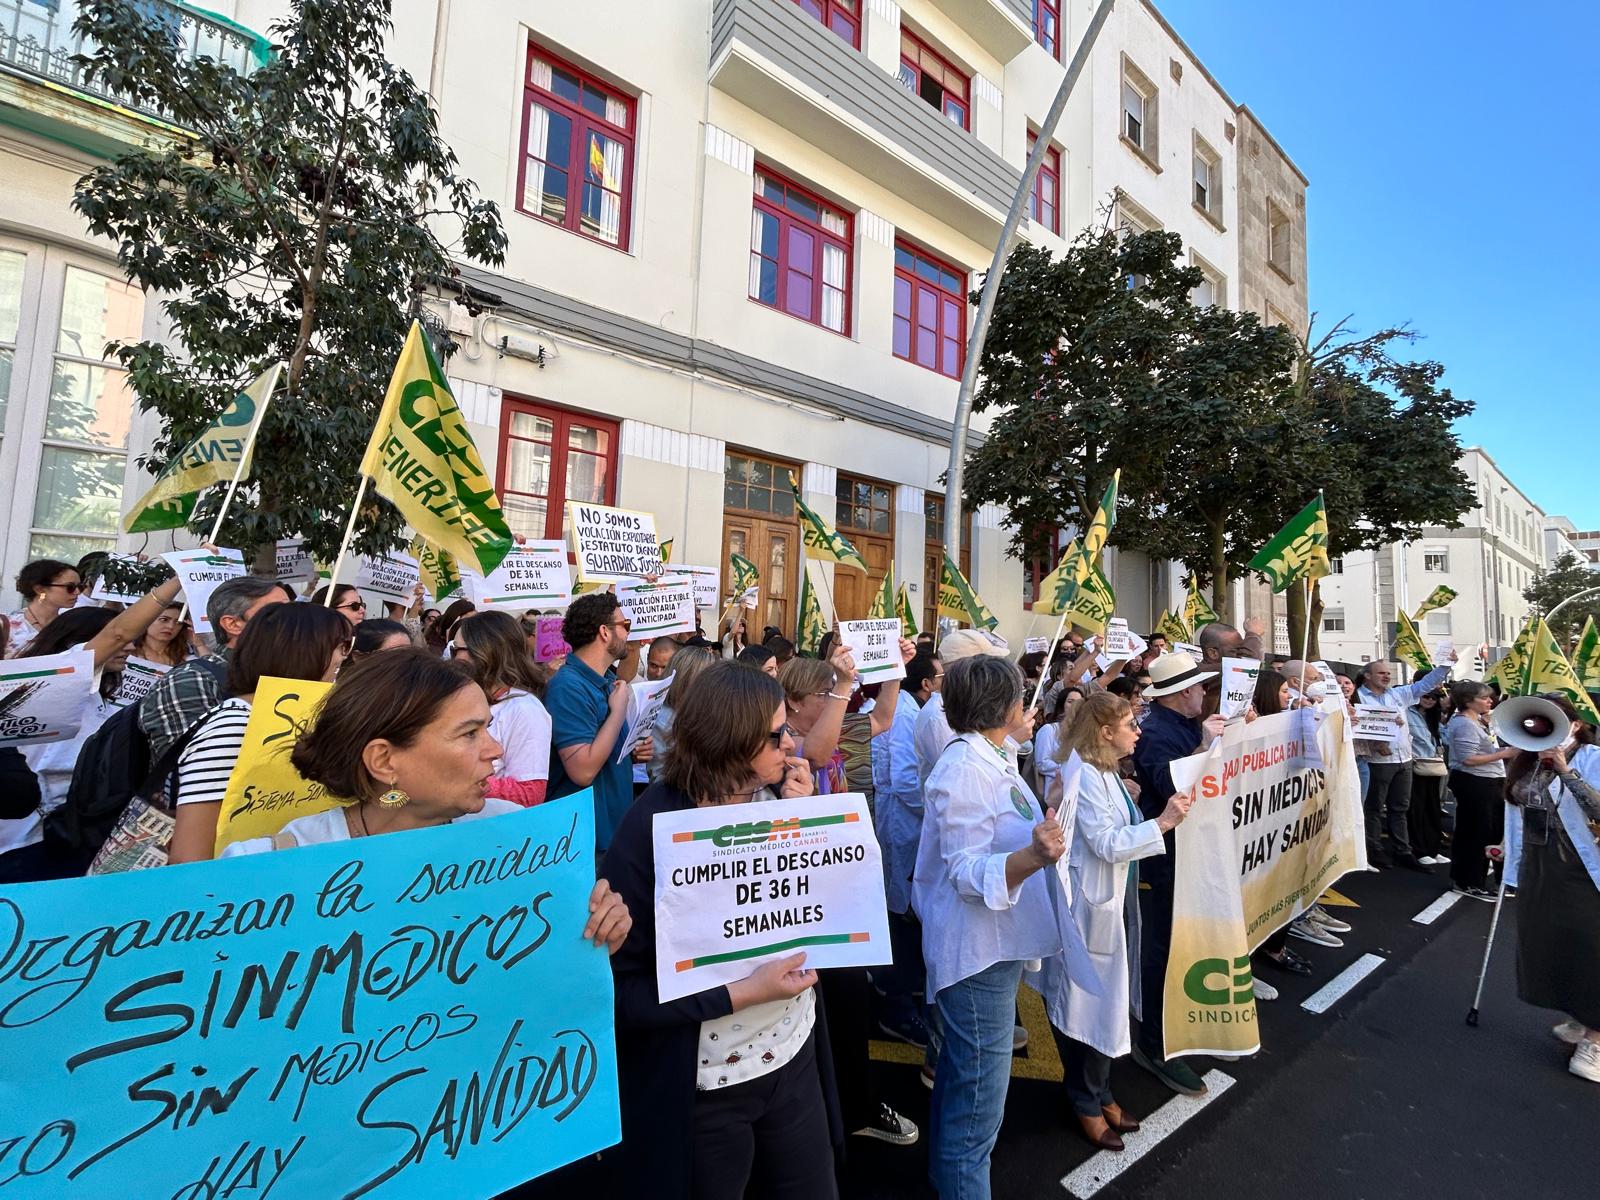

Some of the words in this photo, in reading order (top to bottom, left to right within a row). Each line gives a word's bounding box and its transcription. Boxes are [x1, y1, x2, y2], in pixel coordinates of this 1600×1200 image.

[580, 507, 600, 524] NO
[605, 512, 640, 530] SOMOS
[577, 526, 621, 540] VOCACIÓN
[526, 561, 562, 569] DESCANSO
[372, 571, 406, 585] VOLUNTARIA
[510, 571, 522, 579] DE
[525, 570, 533, 578] 36
[535, 571, 541, 579] H
[370, 580, 404, 592] ANTICIPADA
[505, 582, 549, 591] SEMANALES
[662, 592, 690, 603] FLEXIBLE
[632, 604, 676, 615] VOLUNTARIA
[637, 612, 677, 625] ANTICIPADA
[876, 621, 898, 631] DESCANSO
[867, 635, 875, 646] DE
[863, 650, 889, 662] SEMANALES
[1242, 747, 1285, 774] PÚBLICA
[1287, 740, 1298, 759] EN
[230, 785, 295, 823] SISTEMA
[1232, 789, 1264, 830] SIN
[712, 817, 800, 848] CESM
[712, 846, 757, 858] SINDICATO
[760, 841, 791, 852] MÉDICO
[794, 837, 828, 847] CANARIO
[1241, 830, 1278, 875] HAY
[316, 860, 374, 917] la
[397, 813, 581, 903] sanidad
[672, 859, 747, 887] CUMPLIR
[753, 858, 772, 876] EL
[777, 845, 865, 873] DESCANSO
[736, 881, 762, 906] DE
[769, 878, 791, 900] 36
[797, 875, 809, 895] H
[723, 904, 824, 939] SEMANALES
